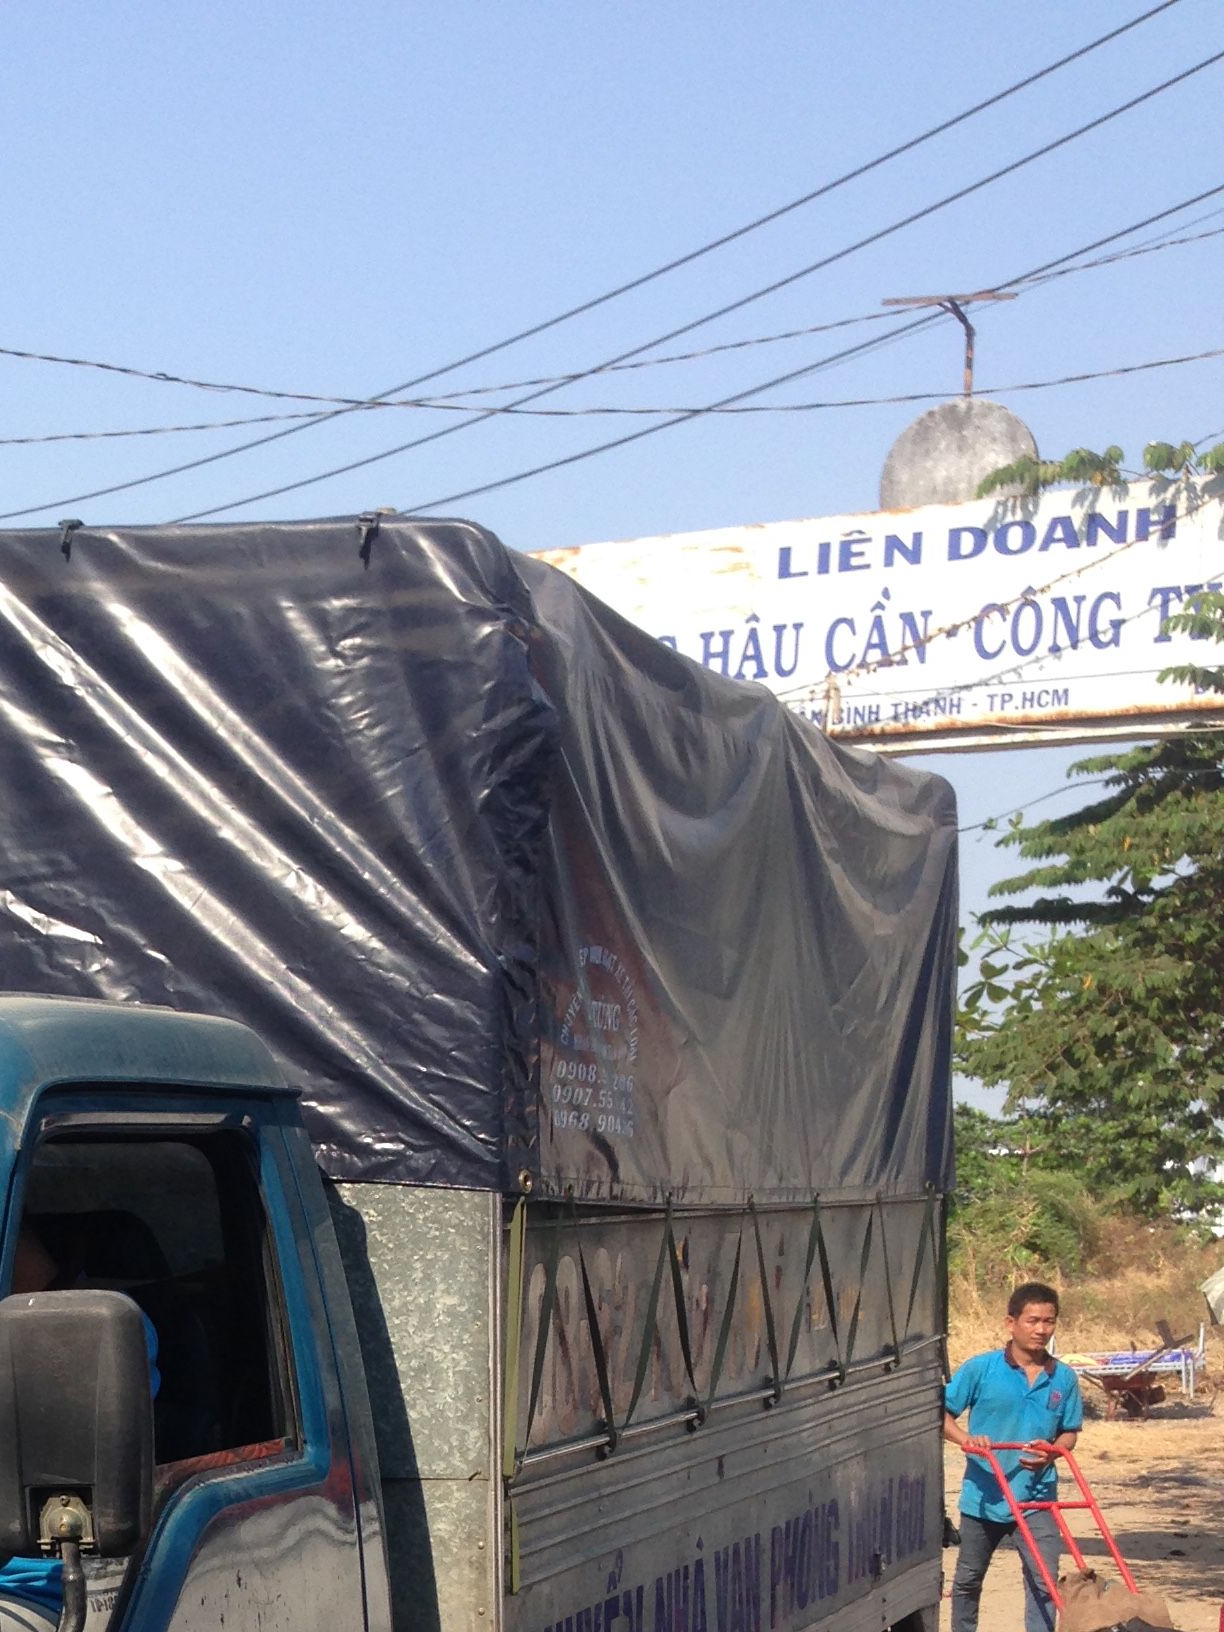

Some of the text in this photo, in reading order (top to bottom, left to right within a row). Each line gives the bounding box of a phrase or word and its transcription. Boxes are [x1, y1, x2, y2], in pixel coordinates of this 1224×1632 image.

[778, 504, 1177, 579] LIÊN DOANH
[824, 586, 933, 673] CẦN
[973, 585, 1127, 660] CÔNG
[986, 687, 1070, 711] TP.HCM
